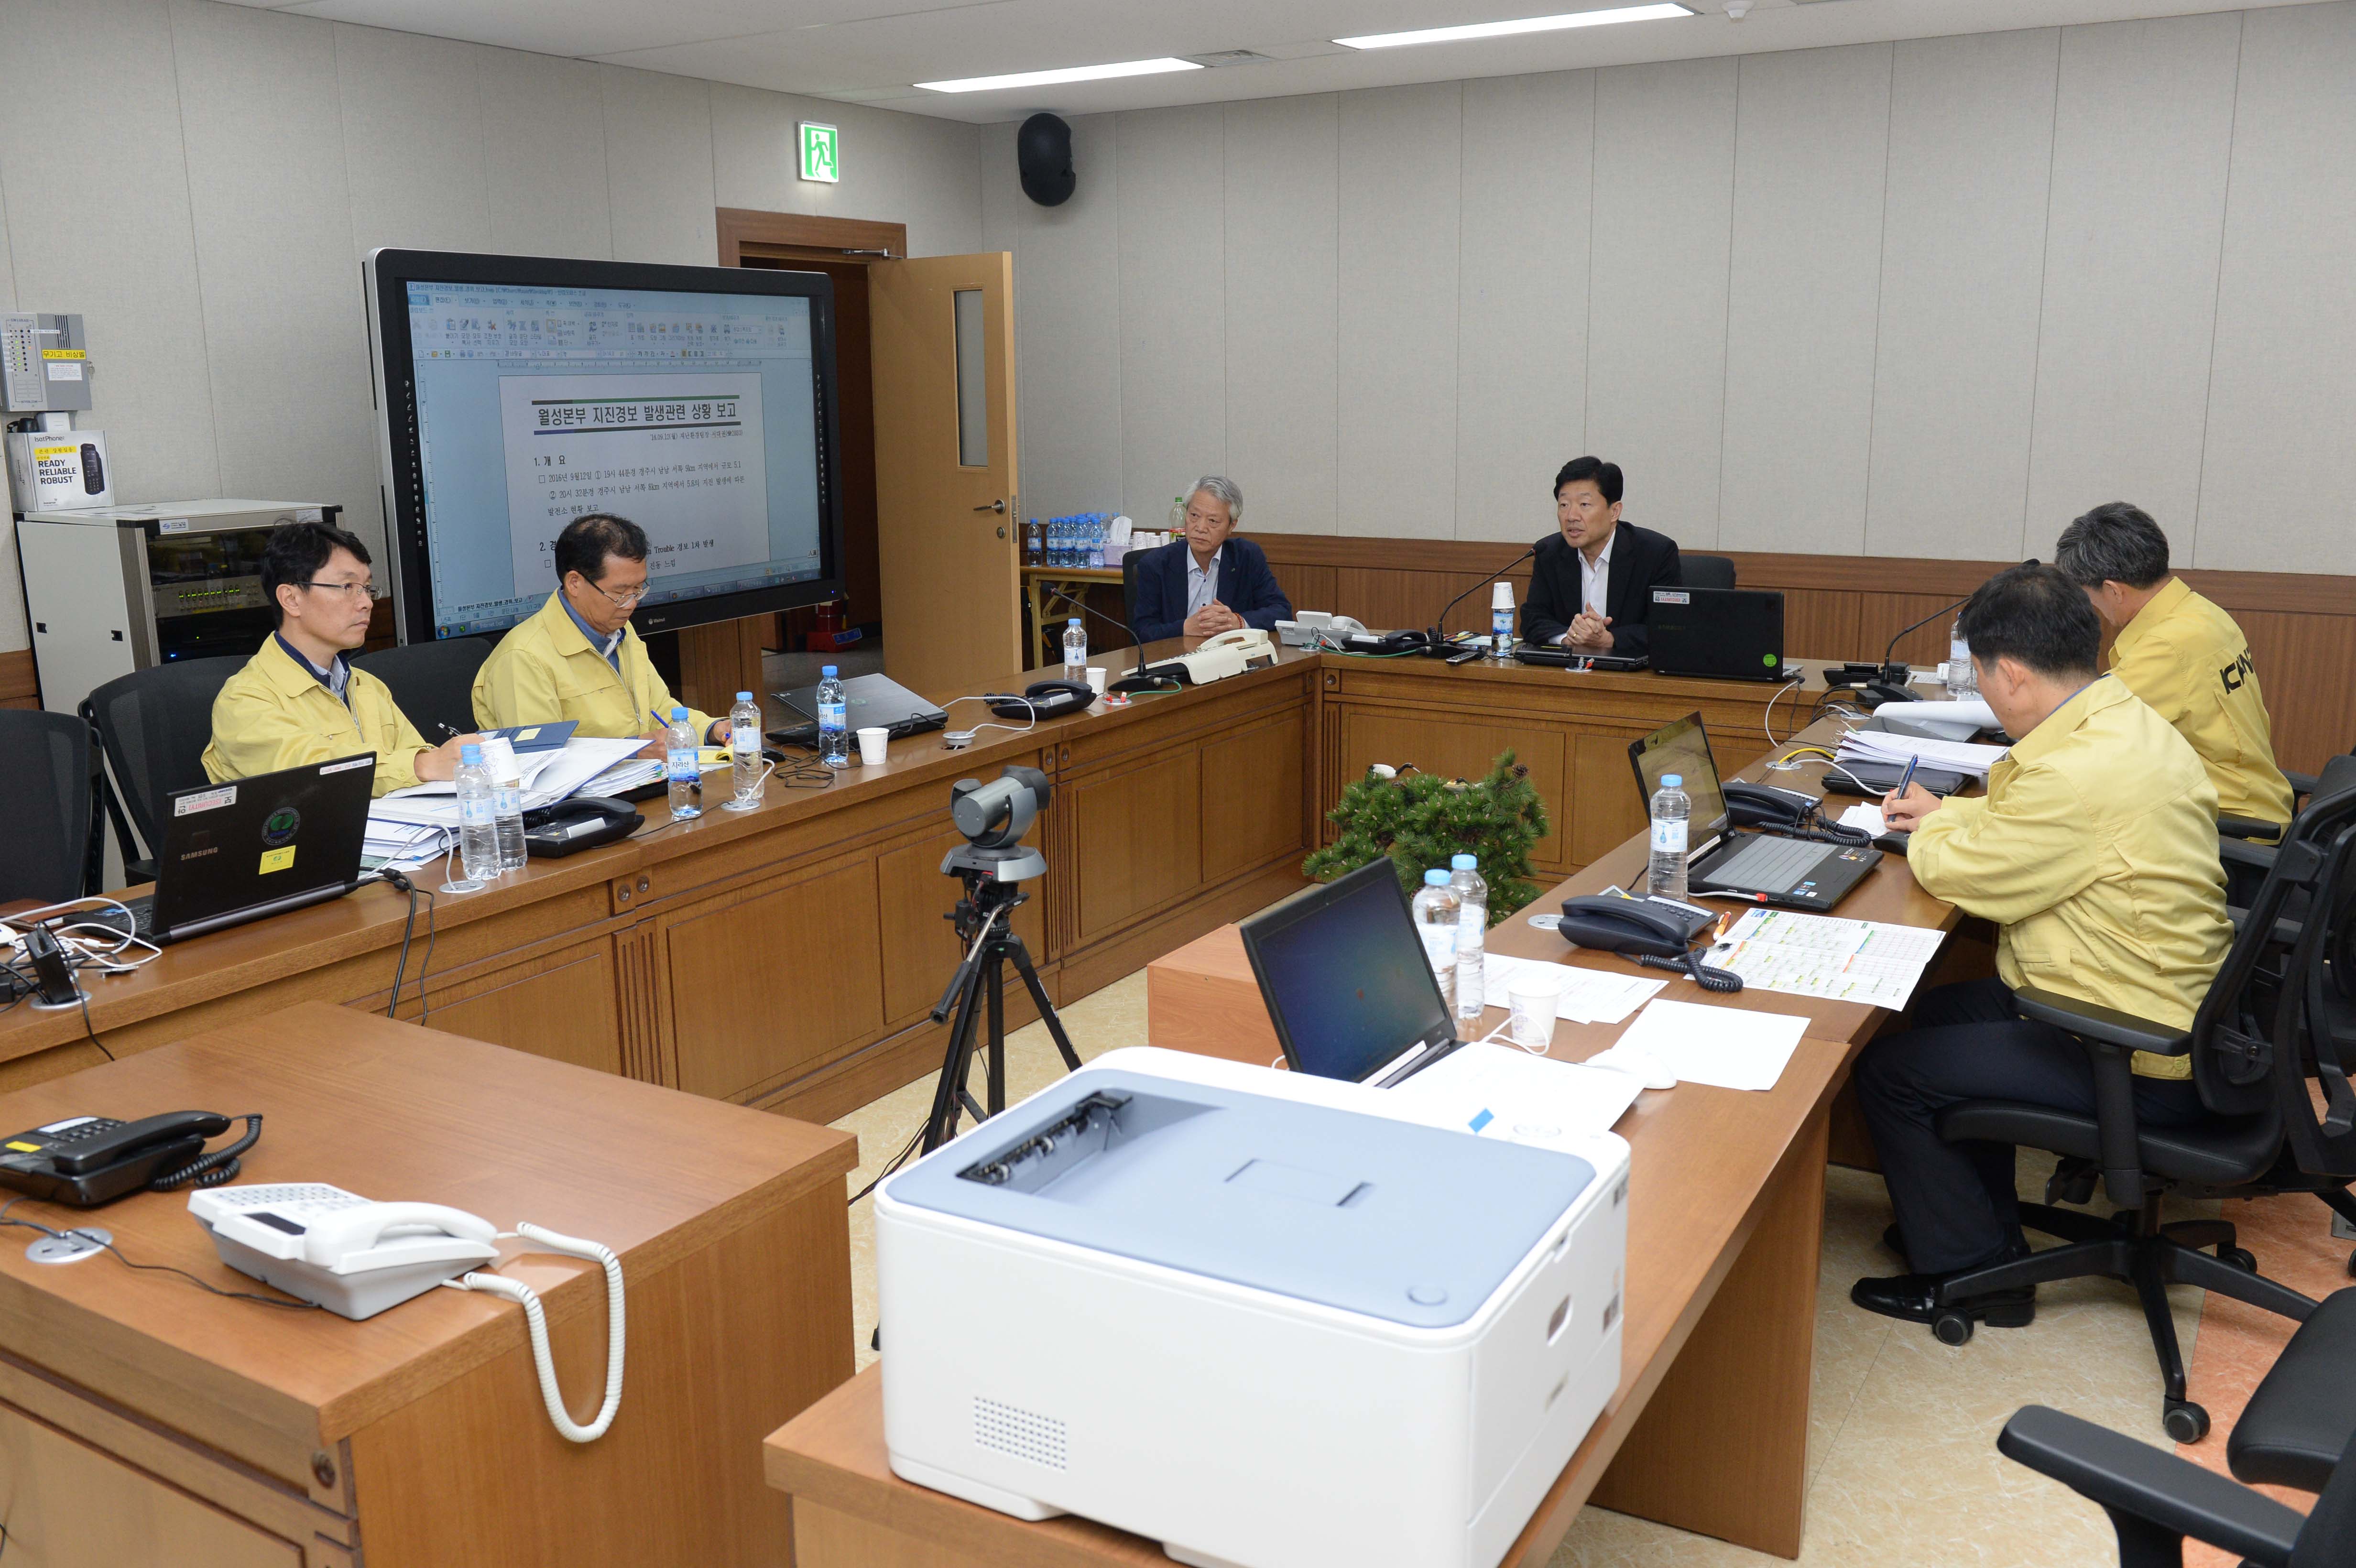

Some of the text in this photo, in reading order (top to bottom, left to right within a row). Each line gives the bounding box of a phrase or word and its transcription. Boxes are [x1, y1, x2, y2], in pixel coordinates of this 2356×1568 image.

[538, 403, 736, 425] 월성본부 지진경보 발생관련 상황 보고
[38, 459, 65, 468] READY
[534, 455, 566, 466] 1. 개 요
[39, 468, 77, 476] RELIABLE
[549, 473, 567, 482] 2016년
[604, 469, 615, 478] 19시
[618, 468, 635, 477] 44분경
[639, 467, 655, 477] 경주시
[658, 465, 669, 474] 남남
[685, 464, 696, 472] 9km
[698, 462, 719, 471] 지역에서
[721, 461, 732, 469] 규모
[41, 476, 73, 485] ROBUST
[559, 489, 572, 498] 20시
[575, 487, 594, 497] 32분경
[598, 485, 616, 496] 경주시
[619, 484, 631, 494] 남남
[648, 482, 659, 490] 8km
[662, 479, 684, 490] 지역에서
[703, 477, 713, 486] 지진
[548, 504, 599, 516] 발전소 현황 보고
[539, 542, 546, 551] 2.
[654, 544, 675, 554] Trouble
[677, 543, 689, 551] 경보
[692, 541, 700, 549] 1차
[703, 539, 714, 548] 발생
[650, 559, 676, 570] 진동 느낌
[672, 761, 689, 769] 지리산
[178, 806, 186, 814] 안
[181, 847, 218, 860] SAMSUNG
